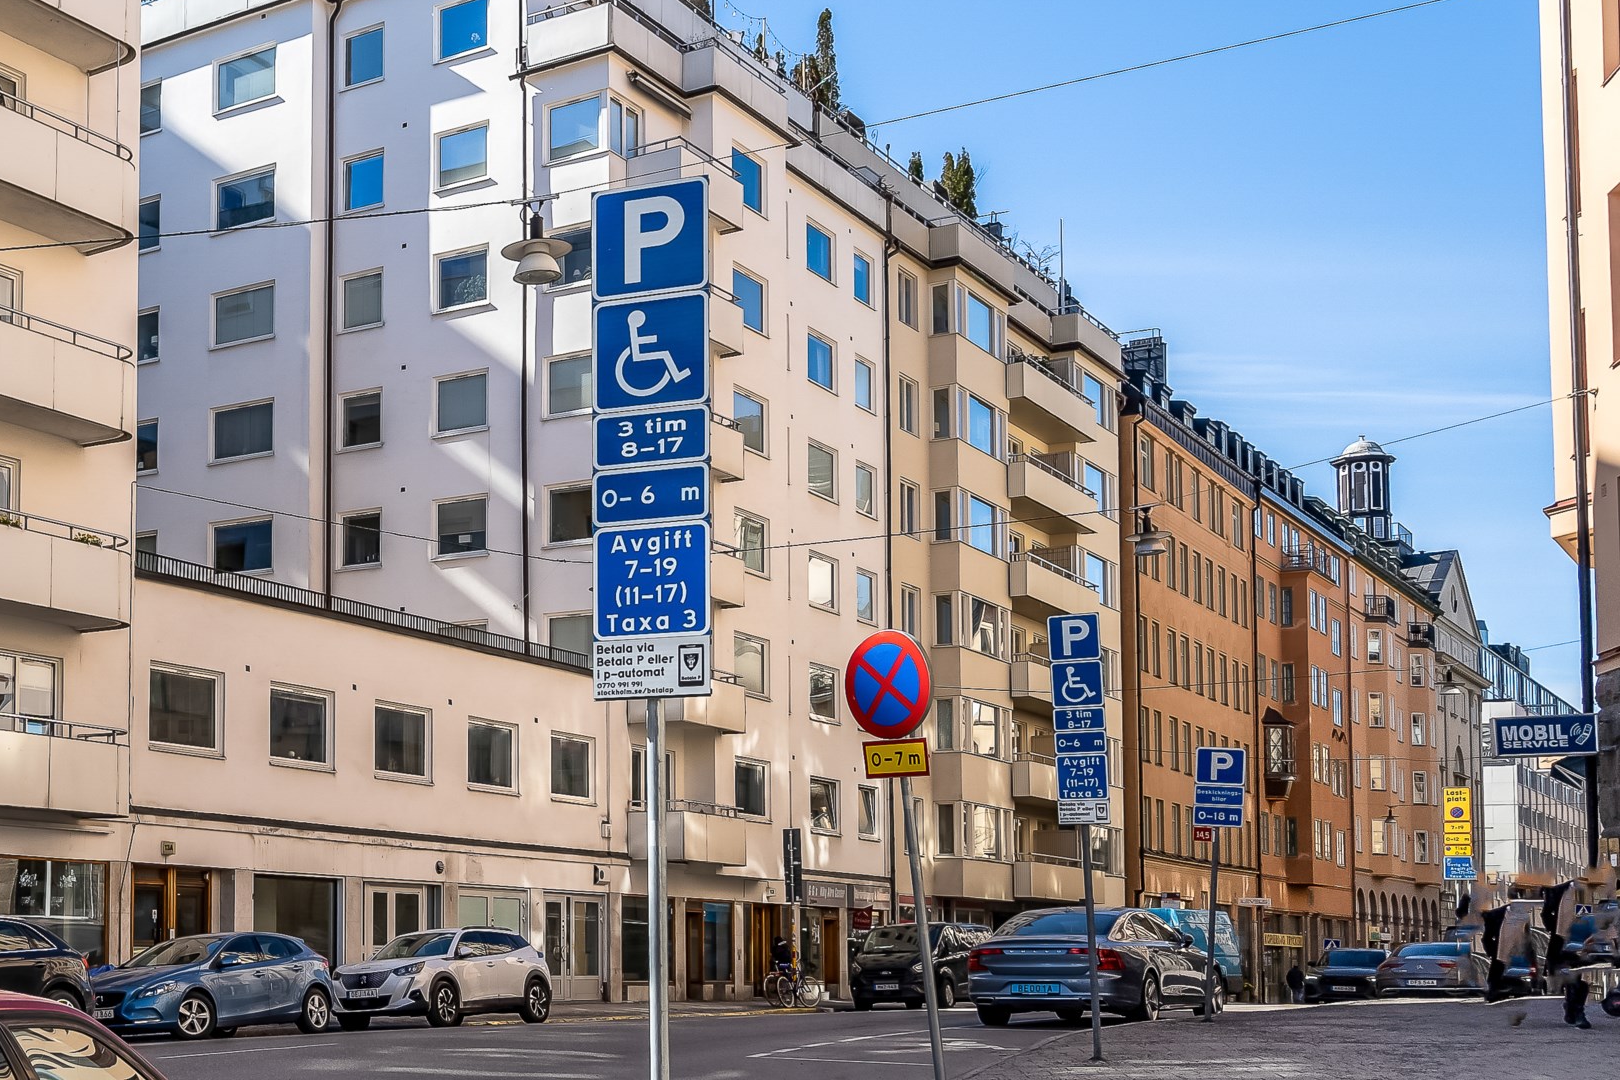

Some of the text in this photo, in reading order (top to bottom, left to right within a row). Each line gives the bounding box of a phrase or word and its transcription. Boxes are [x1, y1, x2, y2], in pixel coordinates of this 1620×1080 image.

[624, 195, 685, 285] P
[618, 418, 687, 437] 3 tim
[621, 436, 683, 458] 8-17
[681, 486, 699, 501] m
[610, 530, 692, 555] Avgift
[624, 557, 678, 579] 7-19
[615, 580, 688, 608] (11-17)
[606, 609, 697, 633] Taxa 3
[1062, 619, 1090, 655] P
[596, 642, 655, 654] Betala via
[596, 654, 674, 667] Betala P eller
[596, 667, 665, 680] i p-automat
[1065, 709, 1092, 719] 3 tim
[1067, 720, 1091, 729] 8-17
[1501, 723, 1568, 742] MOBIL
[1058, 739, 1081, 748] 0-6
[1503, 740, 1569, 749] SERVICE
[871, 751, 921, 767] 0-7 m
[1063, 757, 1100, 768] Avgift
[1070, 768, 1094, 777] 7-19
[1210, 752, 1234, 781] P
[1066, 778, 1099, 788] (11-17)
[1063, 789, 1104, 798] Taxa 3
[1198, 811, 1239, 822] 0-18 m
